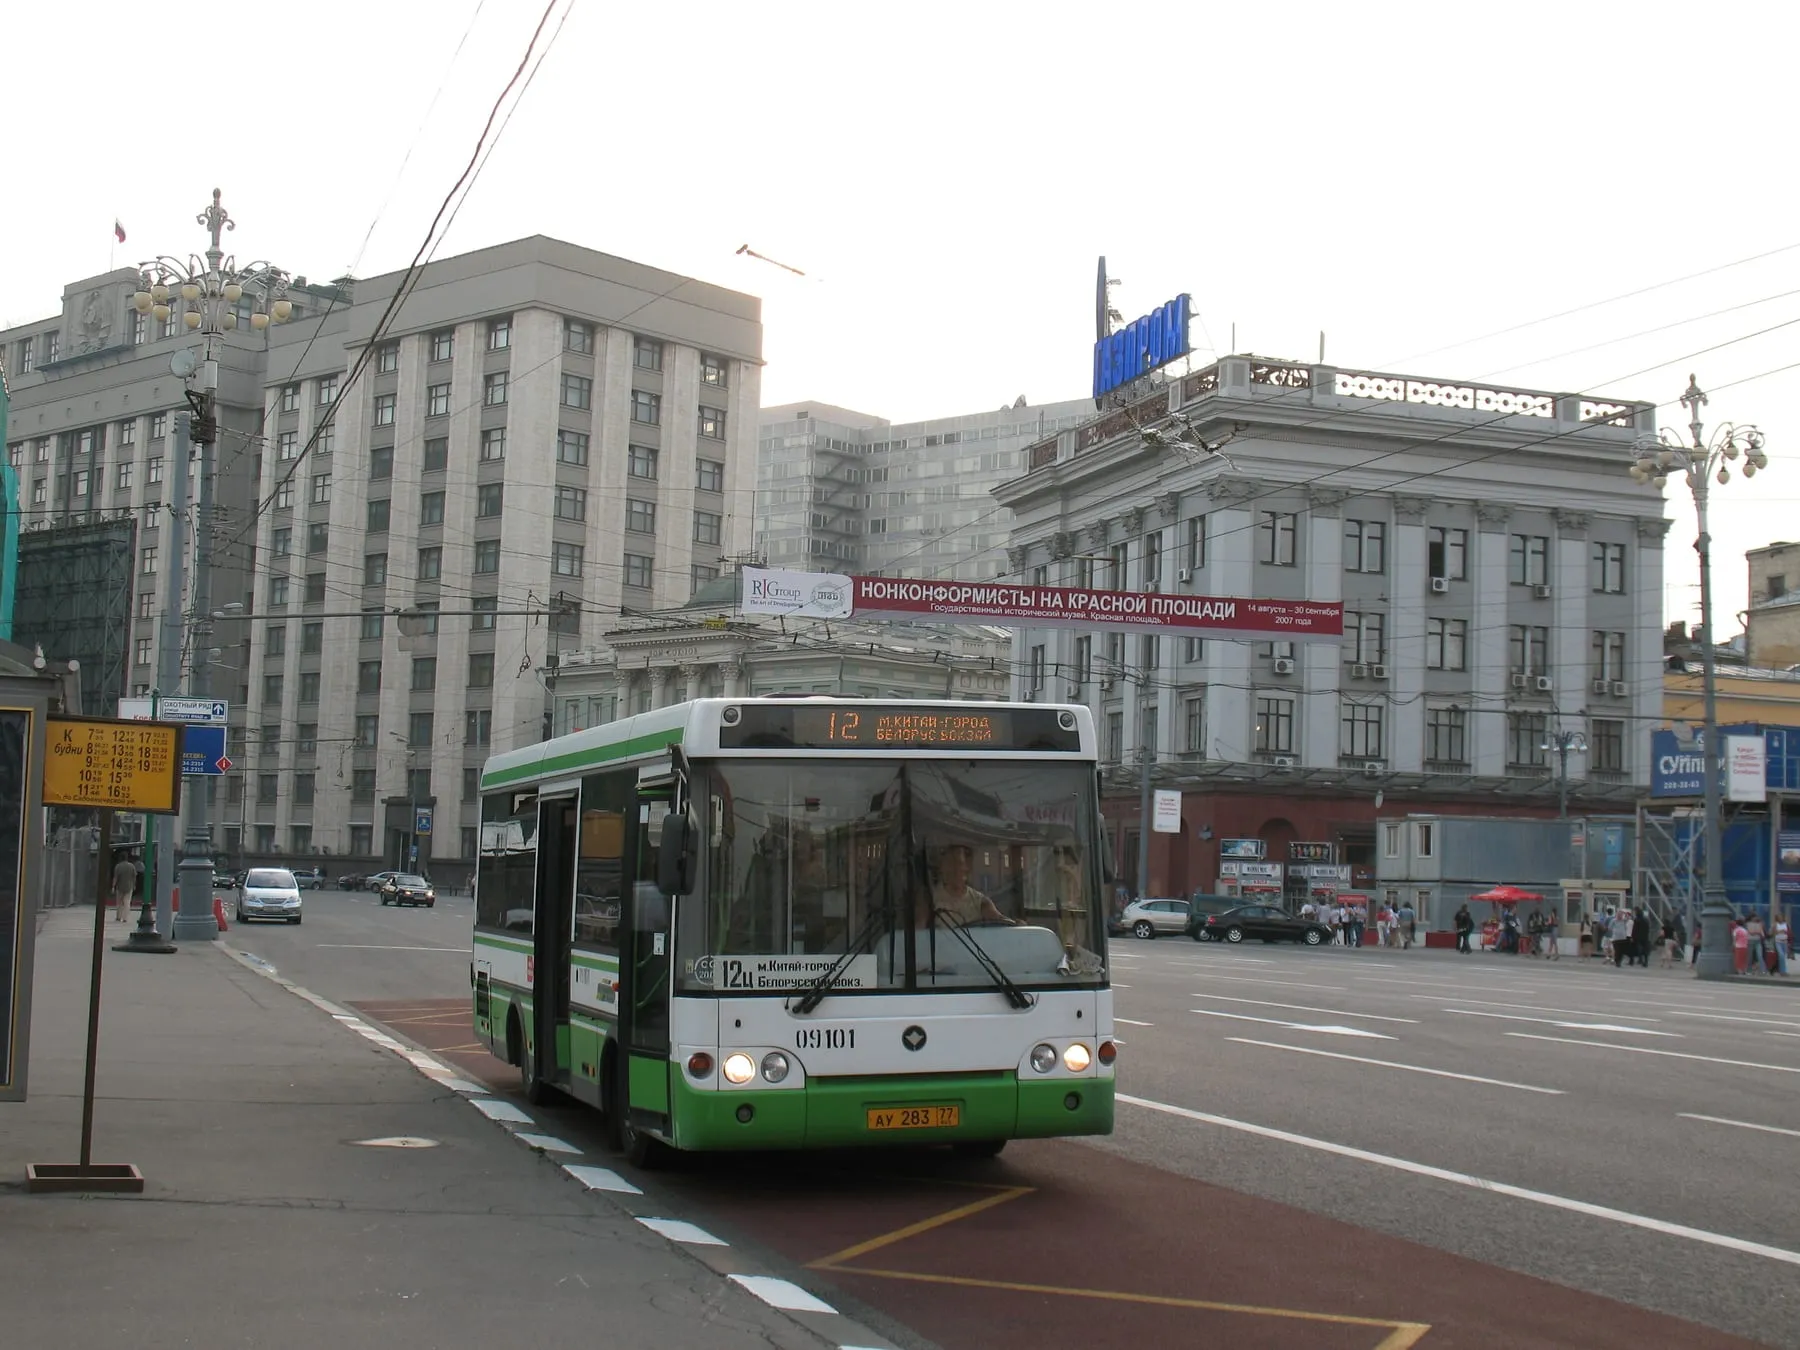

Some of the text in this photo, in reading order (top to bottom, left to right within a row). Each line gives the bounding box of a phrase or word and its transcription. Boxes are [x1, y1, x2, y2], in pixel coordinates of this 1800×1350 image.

[1093, 293, 1190, 398] ГАЗПРОМ
[861, 581, 1035, 607] НОНКОНФОРМИСТЫ
[1041, 592, 1064, 608] НА
[1069, 593, 1146, 613] КРАСНОЙ
[1152, 599, 1235, 619] ПЛОЩАДИ
[930, 603, 1002, 614] Государственный
[1005, 608, 1060, 617] исторический
[1062, 611, 1088, 620] музей.
[1090, 612, 1124, 621] Красная
[1248, 604, 1256, 612] 14
[1258, 605, 1286, 614] августа
[1295, 607, 1304, 615] 30
[1305, 607, 1340, 616] сентября
[1275, 616, 1312, 627] 2007 года
[829, 712, 861, 740] 12
[63, 729, 73, 742] К
[88, 728, 95, 740] 7
[112, 730, 125, 742] 12
[139, 732, 152, 744] 17
[54, 743, 83, 756] будни
[86, 742, 93, 755] 8
[112, 744, 125, 756] 13
[138, 746, 151, 758] 18
[86, 756, 92, 768] 9
[111, 758, 123, 770] 14
[137, 760, 150, 772] 19
[80, 770, 92, 781] 10
[109, 772, 122, 784] 15
[77, 784, 89, 796] 11
[108, 785, 120, 797] 16
[722, 959, 753, 989] 12ц
[796, 1029, 855, 1049] 09101
[901, 1109, 930, 1126] 283
[939, 1107, 953, 1120] 77
